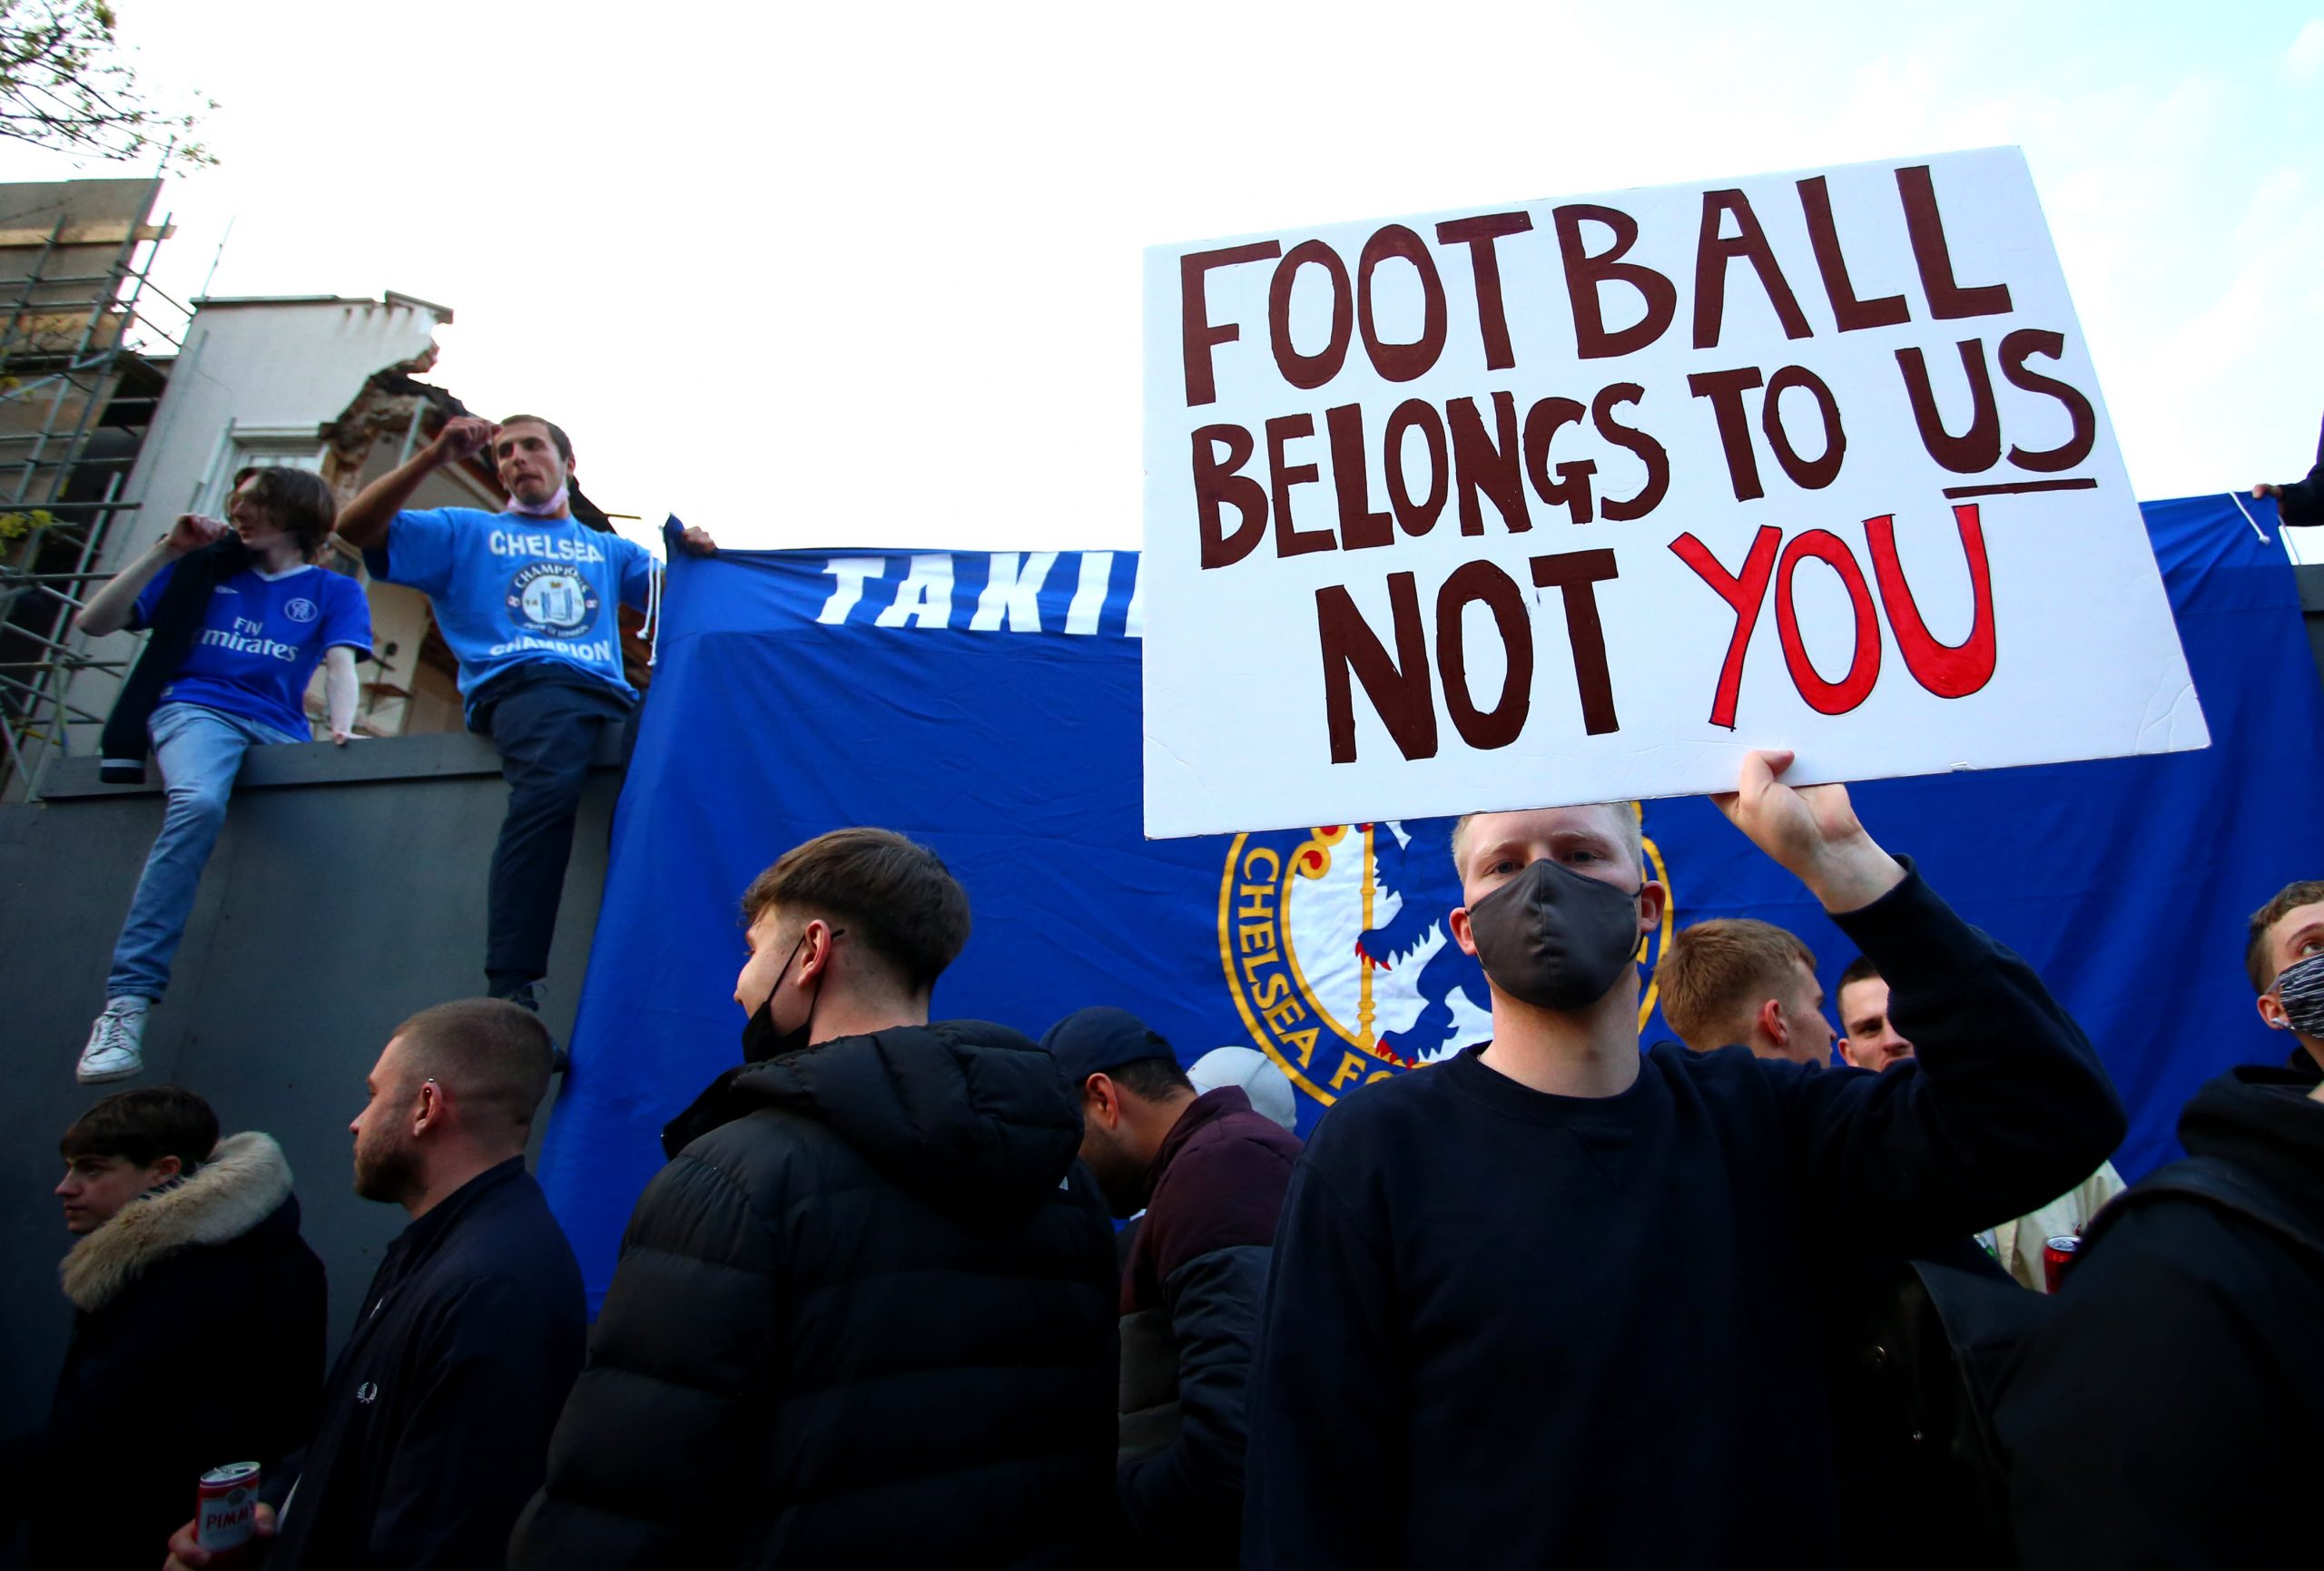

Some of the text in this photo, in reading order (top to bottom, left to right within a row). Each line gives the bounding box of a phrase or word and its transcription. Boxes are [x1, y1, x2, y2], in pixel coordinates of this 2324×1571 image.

[1180, 164, 2014, 407] FOOTBALL
[1191, 328, 2096, 571] BELONGS TO US
[490, 531, 606, 562] CHELSEA
[192, 627, 299, 663] mirates
[233, 616, 263, 636] Fly
[490, 636, 611, 662] CHAMPION
[1315, 503, 1997, 765] NOT YOU
[1237, 847, 1321, 1070] CHELSEA
